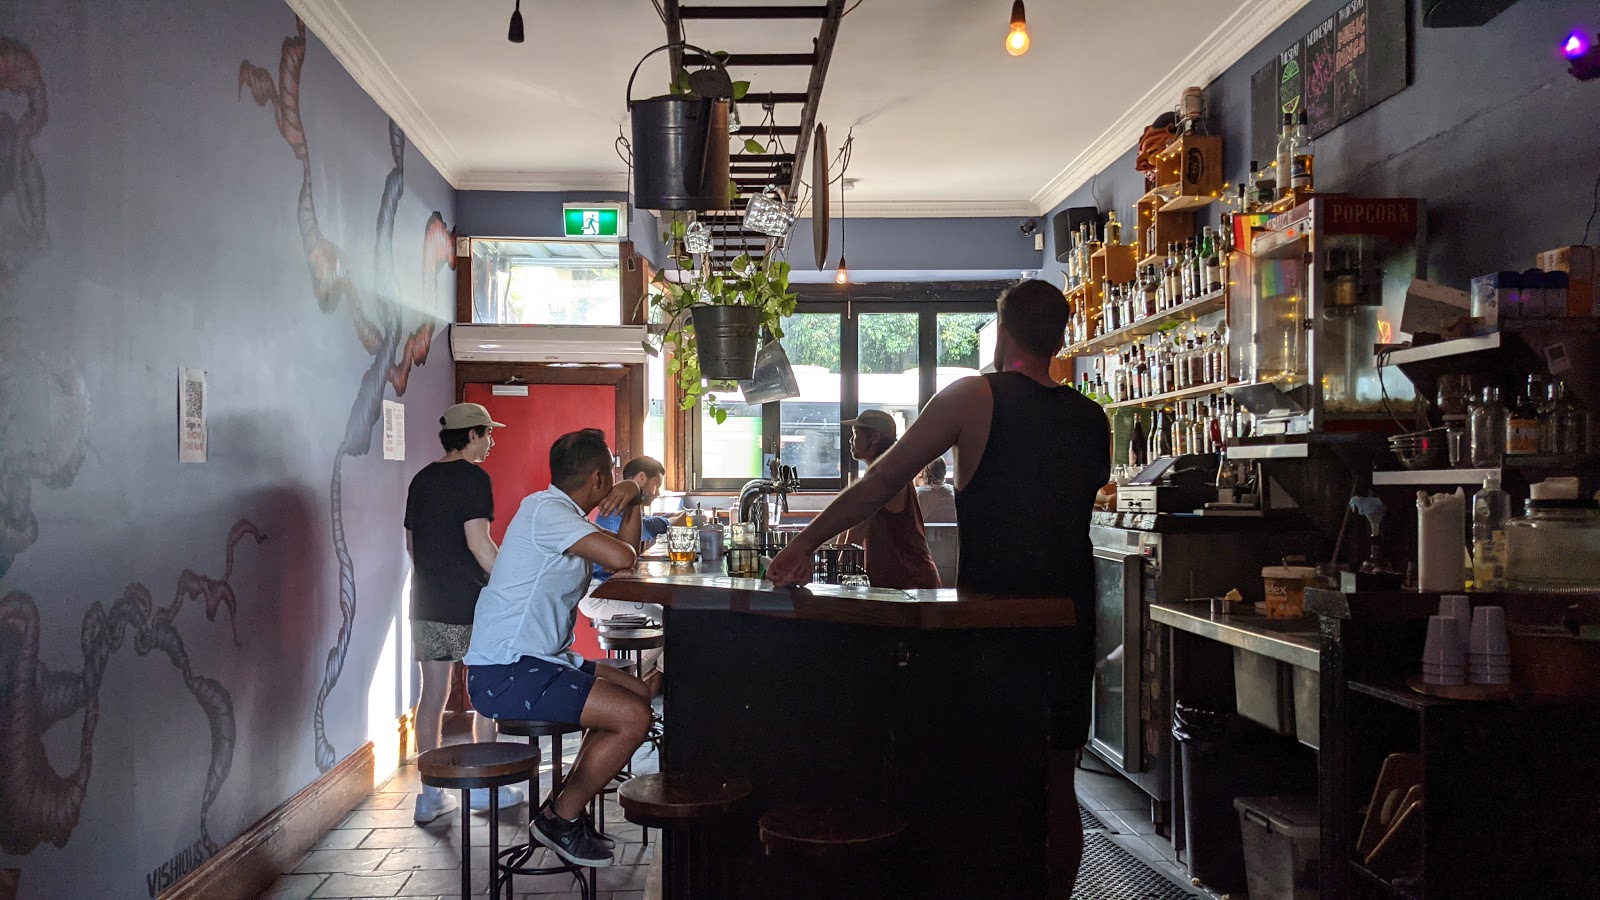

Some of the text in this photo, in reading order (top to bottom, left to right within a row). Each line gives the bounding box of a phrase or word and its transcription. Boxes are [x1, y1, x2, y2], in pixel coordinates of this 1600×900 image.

[1306, 17, 1334, 48] WEDNESDAY
[1280, 42, 1300, 67] TUESDAY
[1331, 203, 1410, 224] POPCORN
